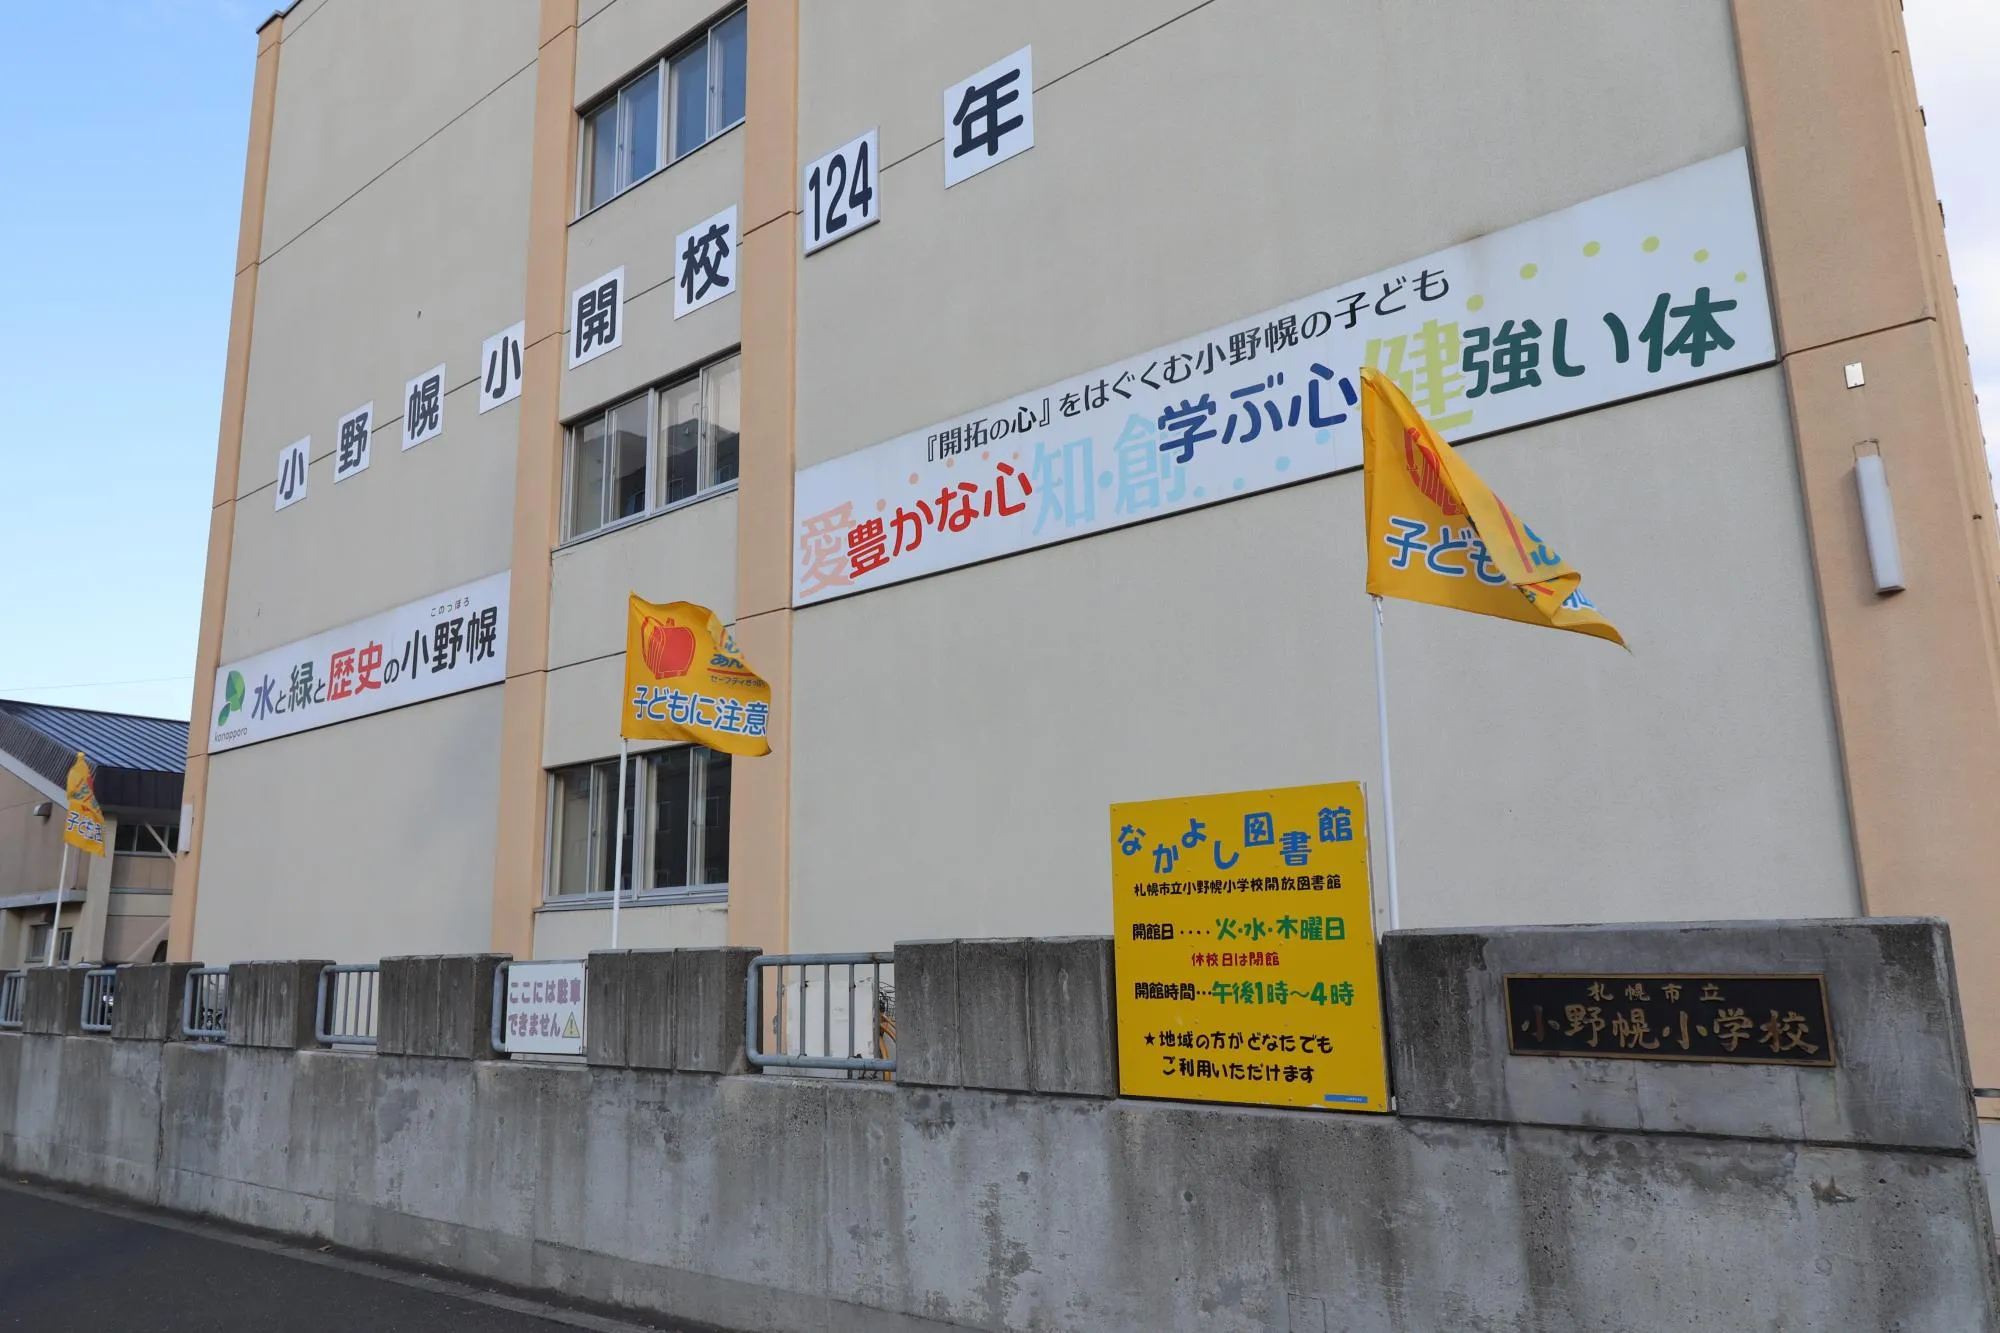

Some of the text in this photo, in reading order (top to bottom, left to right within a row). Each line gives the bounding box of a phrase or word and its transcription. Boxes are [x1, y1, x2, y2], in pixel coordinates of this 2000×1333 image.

[1462, 286, 1737, 399] 強い体
[1157, 362, 1358, 464] 学ぶ心
[846, 461, 1033, 580] 豊かな心
[633, 686, 769, 736] 子どもに注意
[1117, 806, 1353, 874] なかよし図書館
[1134, 874, 1342, 897] 札幌市立小野幌小学校開放図書館
[1191, 951, 1280, 967] 休校日は閉館
[1521, 1004, 1819, 1054] 小野幌小学校
[1162, 1055, 1315, 1083] ご利用いただけます
